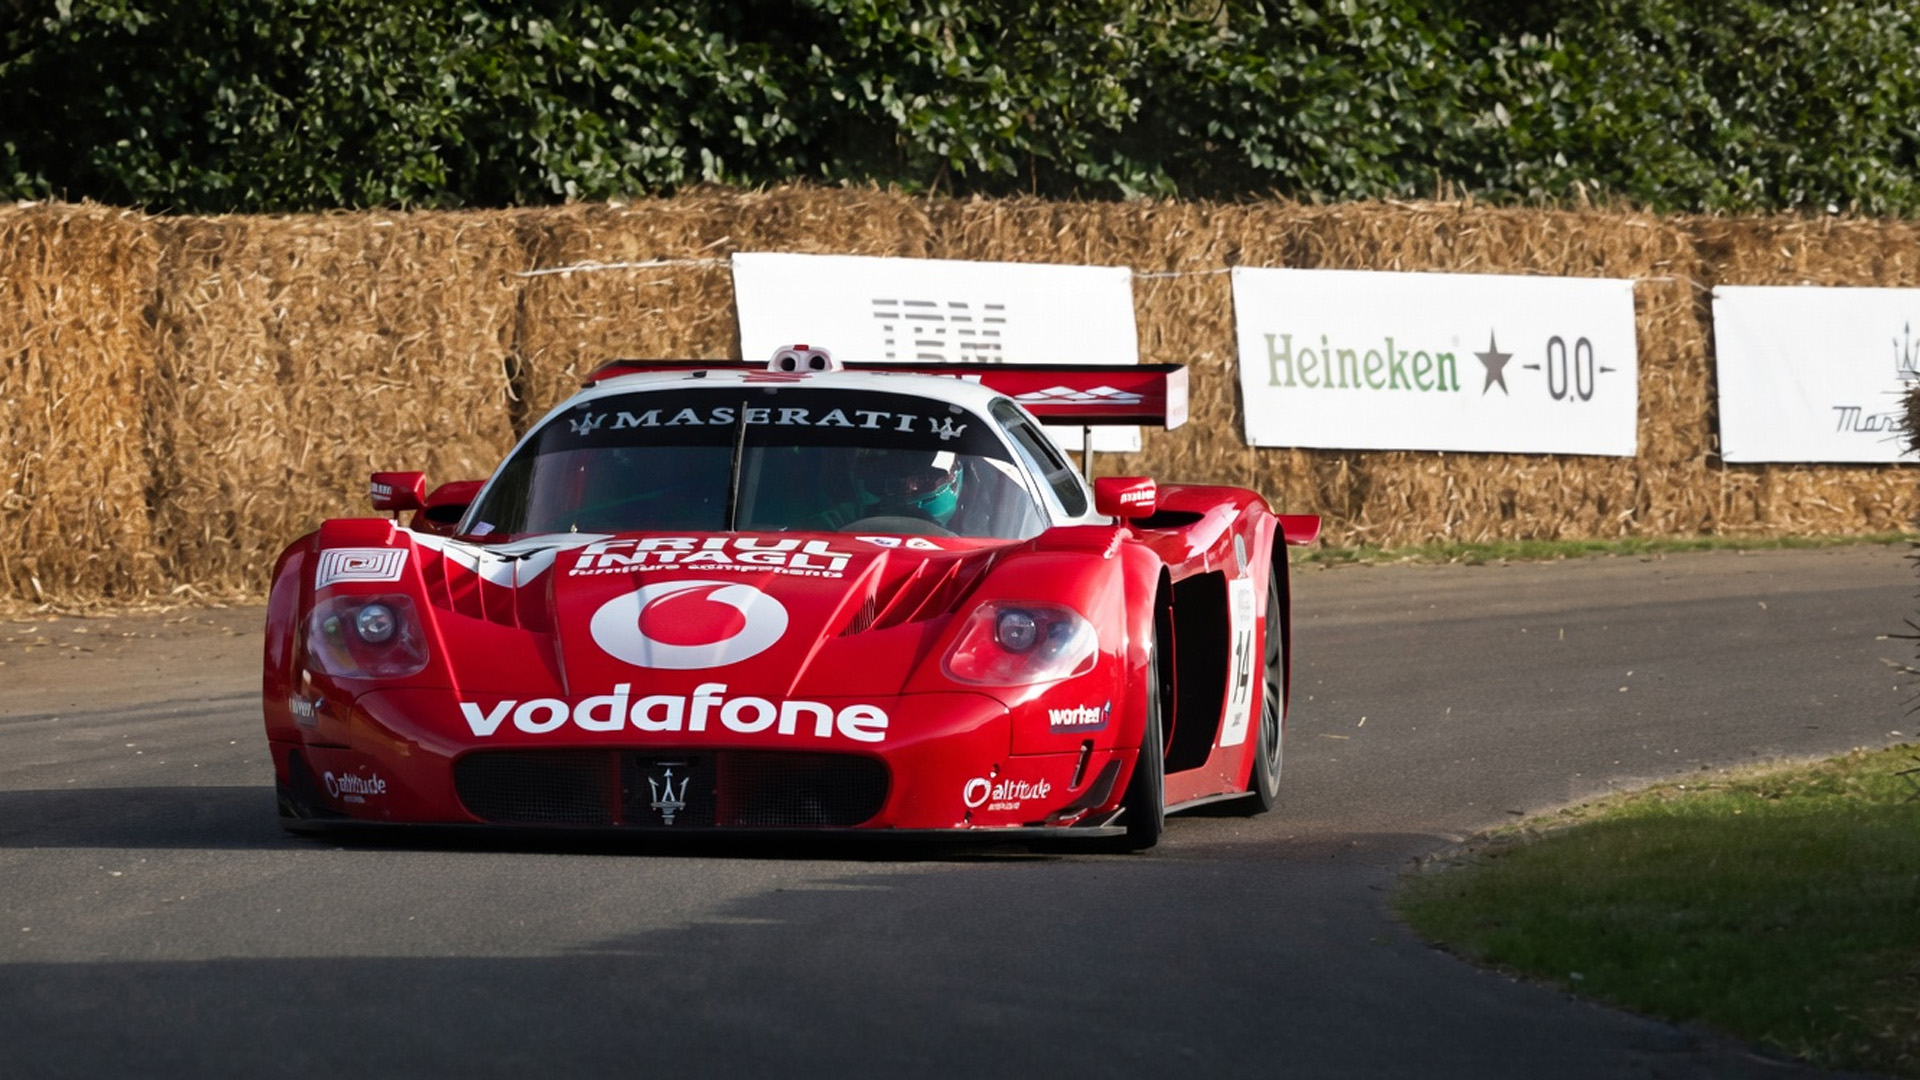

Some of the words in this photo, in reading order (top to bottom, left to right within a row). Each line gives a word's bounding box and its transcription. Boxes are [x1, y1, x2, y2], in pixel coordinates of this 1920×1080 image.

[872, 299, 1006, 362] IBM
[1263, 332, 1461, 393] Heineken
[610, 407, 918, 433] MASERATI
[575, 550, 850, 571] INTAGLI
[581, 537, 853, 558] FRIUL
[460, 683, 888, 742] vodafone
